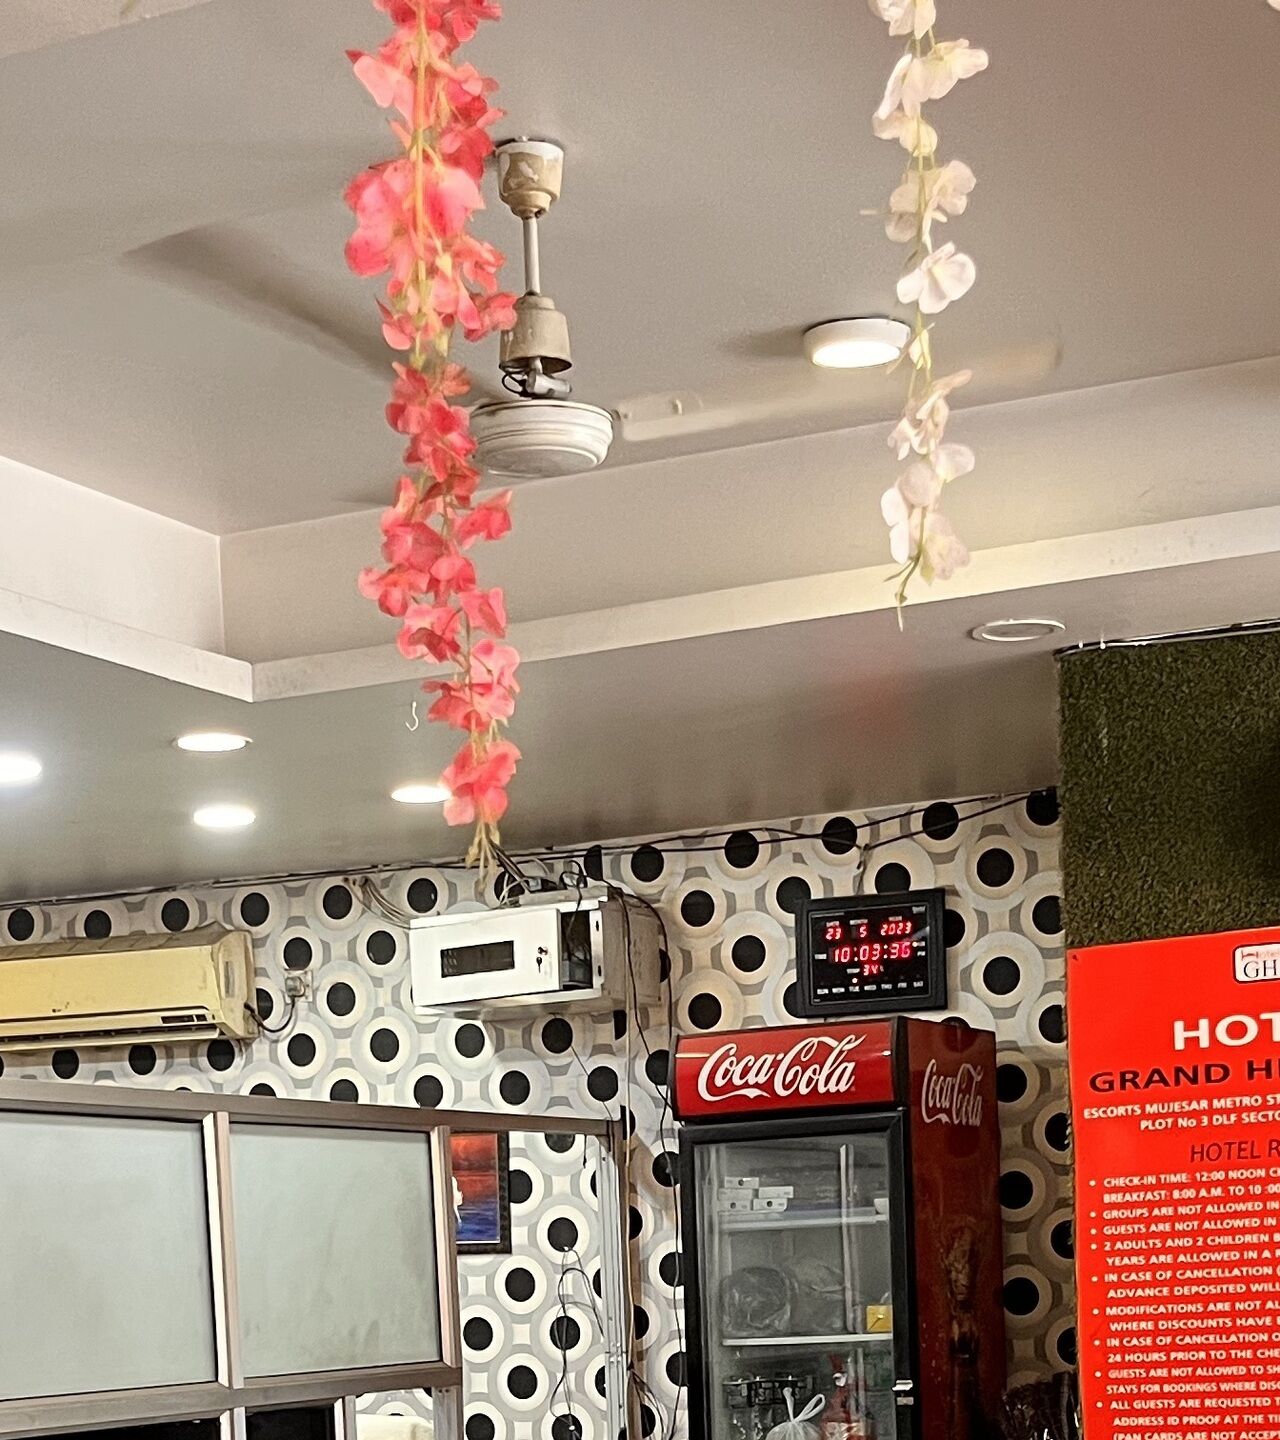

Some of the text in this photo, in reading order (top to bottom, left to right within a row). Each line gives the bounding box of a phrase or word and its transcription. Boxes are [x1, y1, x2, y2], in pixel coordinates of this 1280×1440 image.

[826, 928, 841, 940] 23
[860, 925, 867, 937] 5
[881, 921, 912, 935] 2023
[835, 942, 910, 962] 10:03:36
[1243, 958, 1277, 978] GH
[698, 1034, 867, 1101] Coca-Cola
[1088, 1061, 1232, 1094] GRAND
[1083, 1104, 1141, 1119] ESCORTS
[1145, 1099, 1208, 1114] MUJESAR
[1212, 1094, 1262, 1109] METRO
[1140, 1117, 1173, 1130] PLOT
[1177, 1116, 1196, 1128] No
[1200, 1115, 1208, 1126] 3
[1212, 1113, 1237, 1125] DLF
[1189, 1139, 1261, 1163] HOTEL
[1103, 1174, 1156, 1187] CHECK-IN
[1159, 1172, 1191, 1184] TIME:
[1195, 1170, 1225, 1182] 12:00
[1227, 1167, 1265, 1179] NOON
[1172, 1188, 1196, 1199] 8:00
[1198, 1186, 1226, 1197] A.M.
[1228, 1185, 1245, 1196] TO
[1102, 1207, 1149, 1219] GROUPS
[1151, 1206, 1174, 1216] ARE
[1177, 1204, 1202, 1215] NOT
[1205, 1201, 1263, 1213] ALLOWED
[1266, 1200, 1279, 1209] IN
[1103, 1223, 1146, 1235] GUESTS
[1148, 1222, 1170, 1232] ARE
[1174, 1220, 1198, 1231] NOT
[1202, 1217, 1260, 1230] ALLOWED
[1263, 1216, 1276, 1226] IN
[1104, 1241, 1110, 1250] 2
[1113, 1238, 1162, 1250] ADULTS
[1165, 1237, 1193, 1247] AND
[1195, 1236, 1203, 1246] 2
[1206, 1233, 1269, 1245] CHILDREN
[1106, 1255, 1145, 1266] YEARS
[1148, 1254, 1173, 1264] ARE
[1176, 1250, 1240, 1263] ALLOWED
[1243, 1250, 1257, 1259] IN
[1261, 1249, 1271, 1258] A
[1107, 1286, 1169, 1298] ADVANCE
[1173, 1283, 1246, 1295] DEPOSITED
[1184, 1431, 1207, 1440] ARE
[1210, 1431, 1235, 1440] NOT
